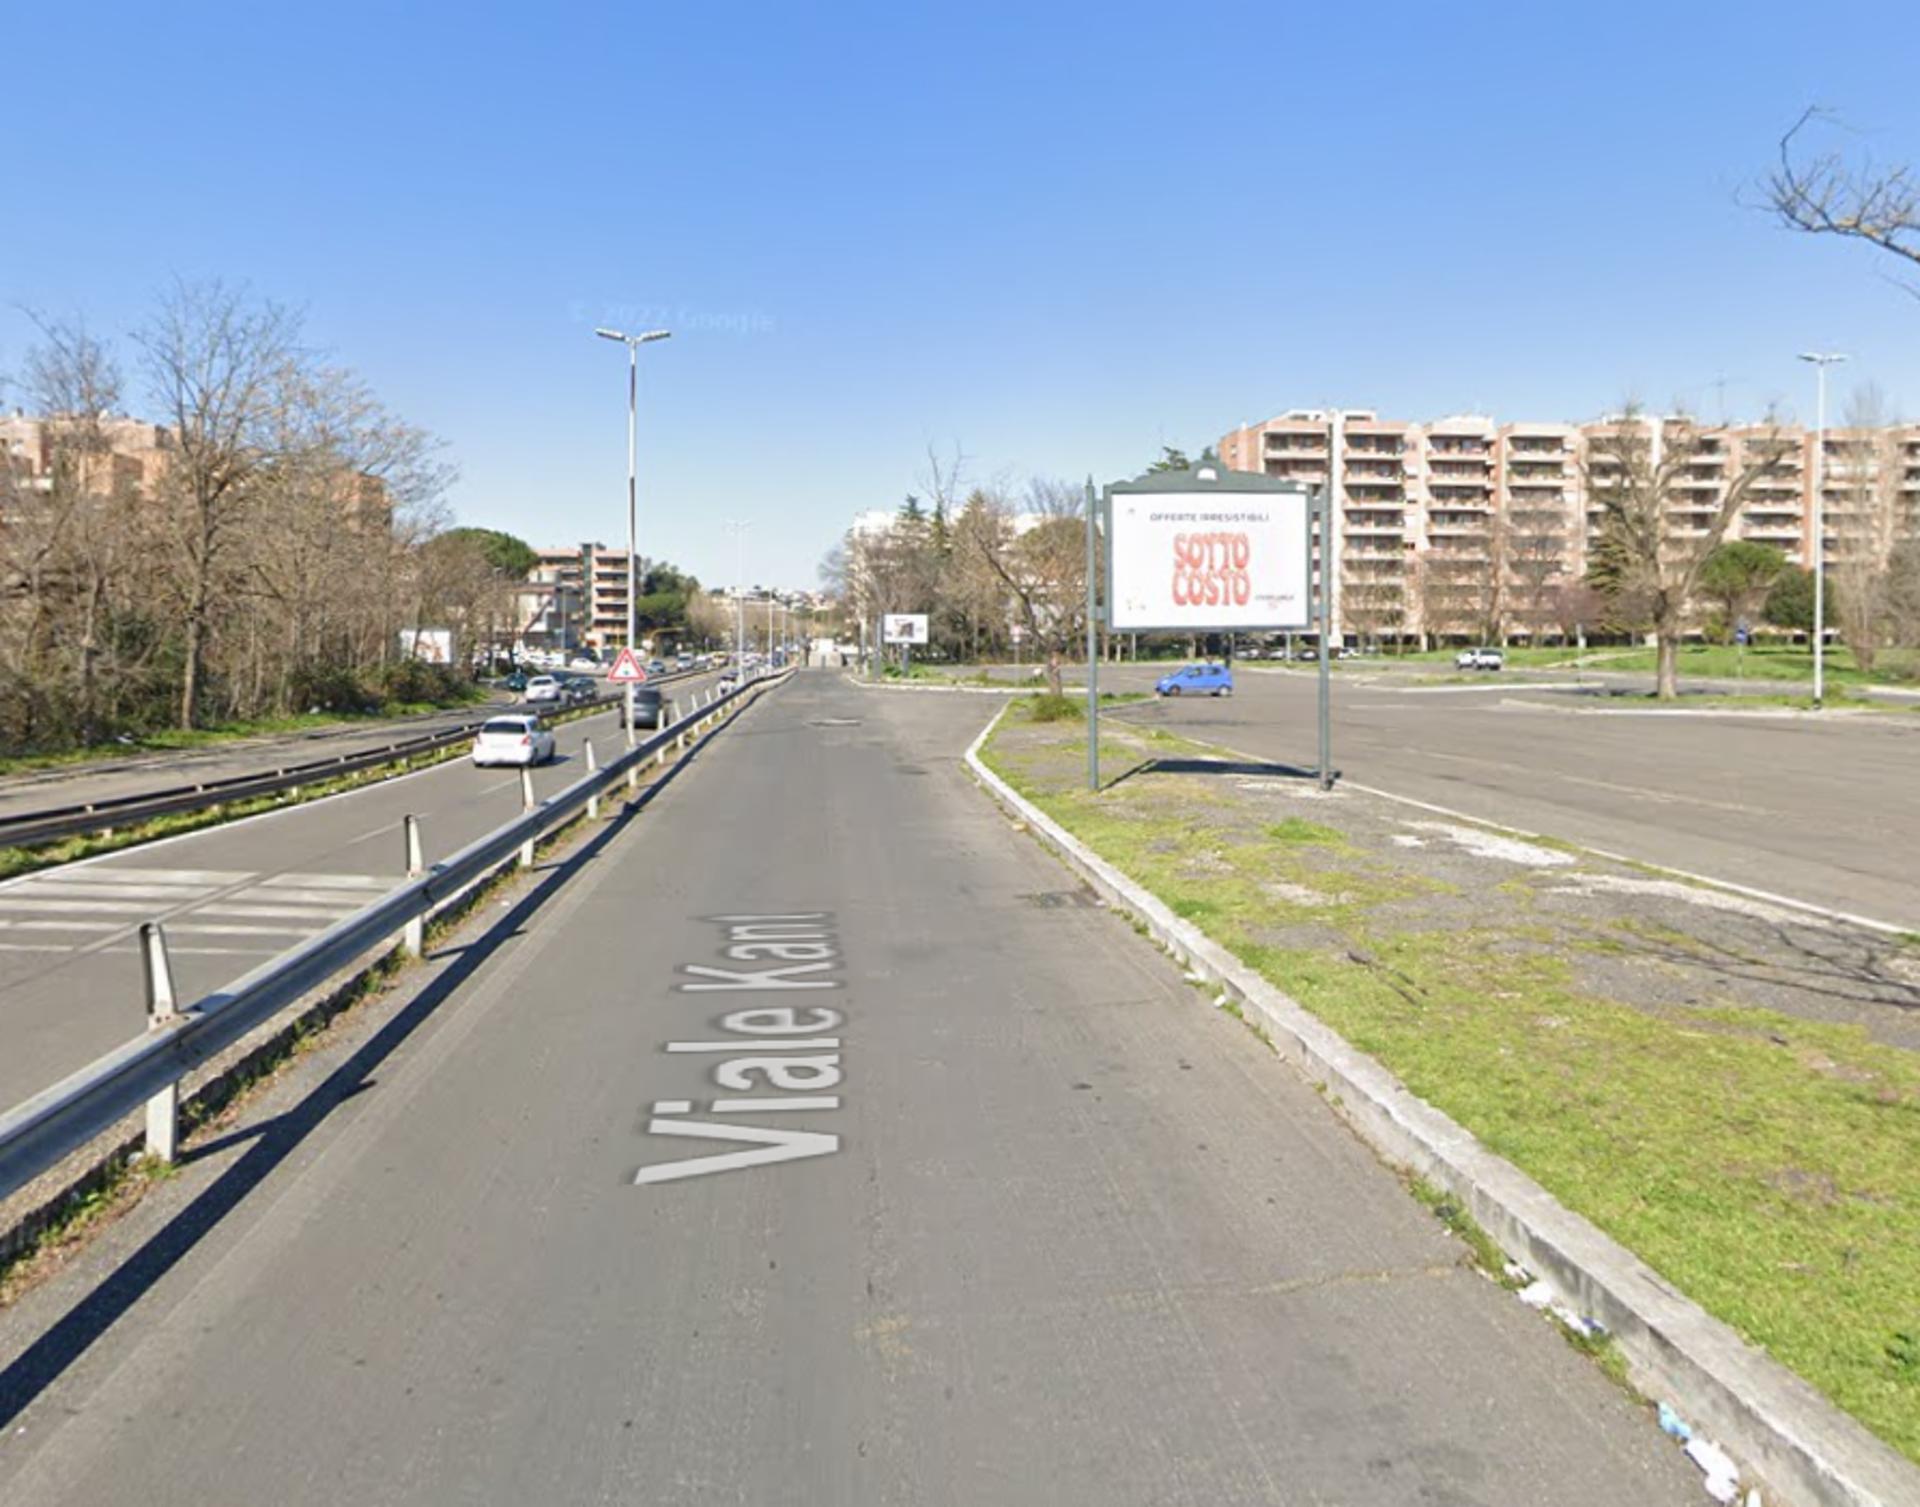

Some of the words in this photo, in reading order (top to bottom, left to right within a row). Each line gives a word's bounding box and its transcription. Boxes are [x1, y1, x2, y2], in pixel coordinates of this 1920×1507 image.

[1149, 512, 1197, 522] OFFERTE
[1199, 512, 1270, 522] IRRESISTIBILI
[1173, 533, 1249, 570] SOTTO
[1172, 570, 1250, 606] COSTO
